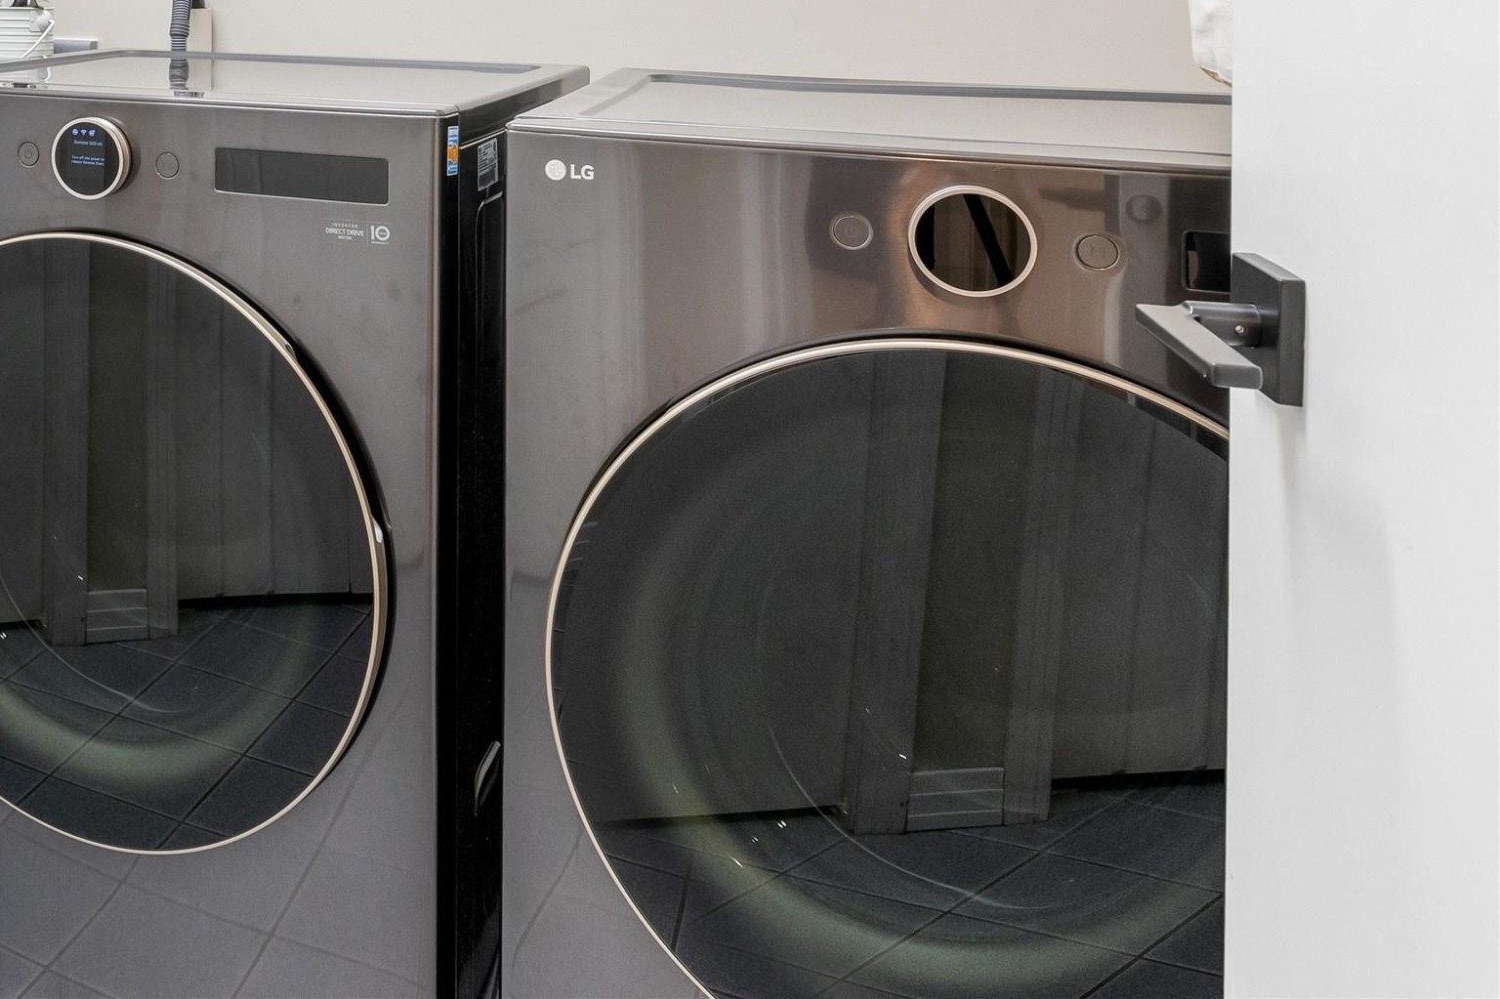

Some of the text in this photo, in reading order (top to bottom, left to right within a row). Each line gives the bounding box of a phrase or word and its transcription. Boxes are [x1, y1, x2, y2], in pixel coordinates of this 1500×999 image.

[569, 163, 595, 180] LG
[325, 227, 365, 237] DIRECT DRIVE
[370, 224, 391, 242] 10
